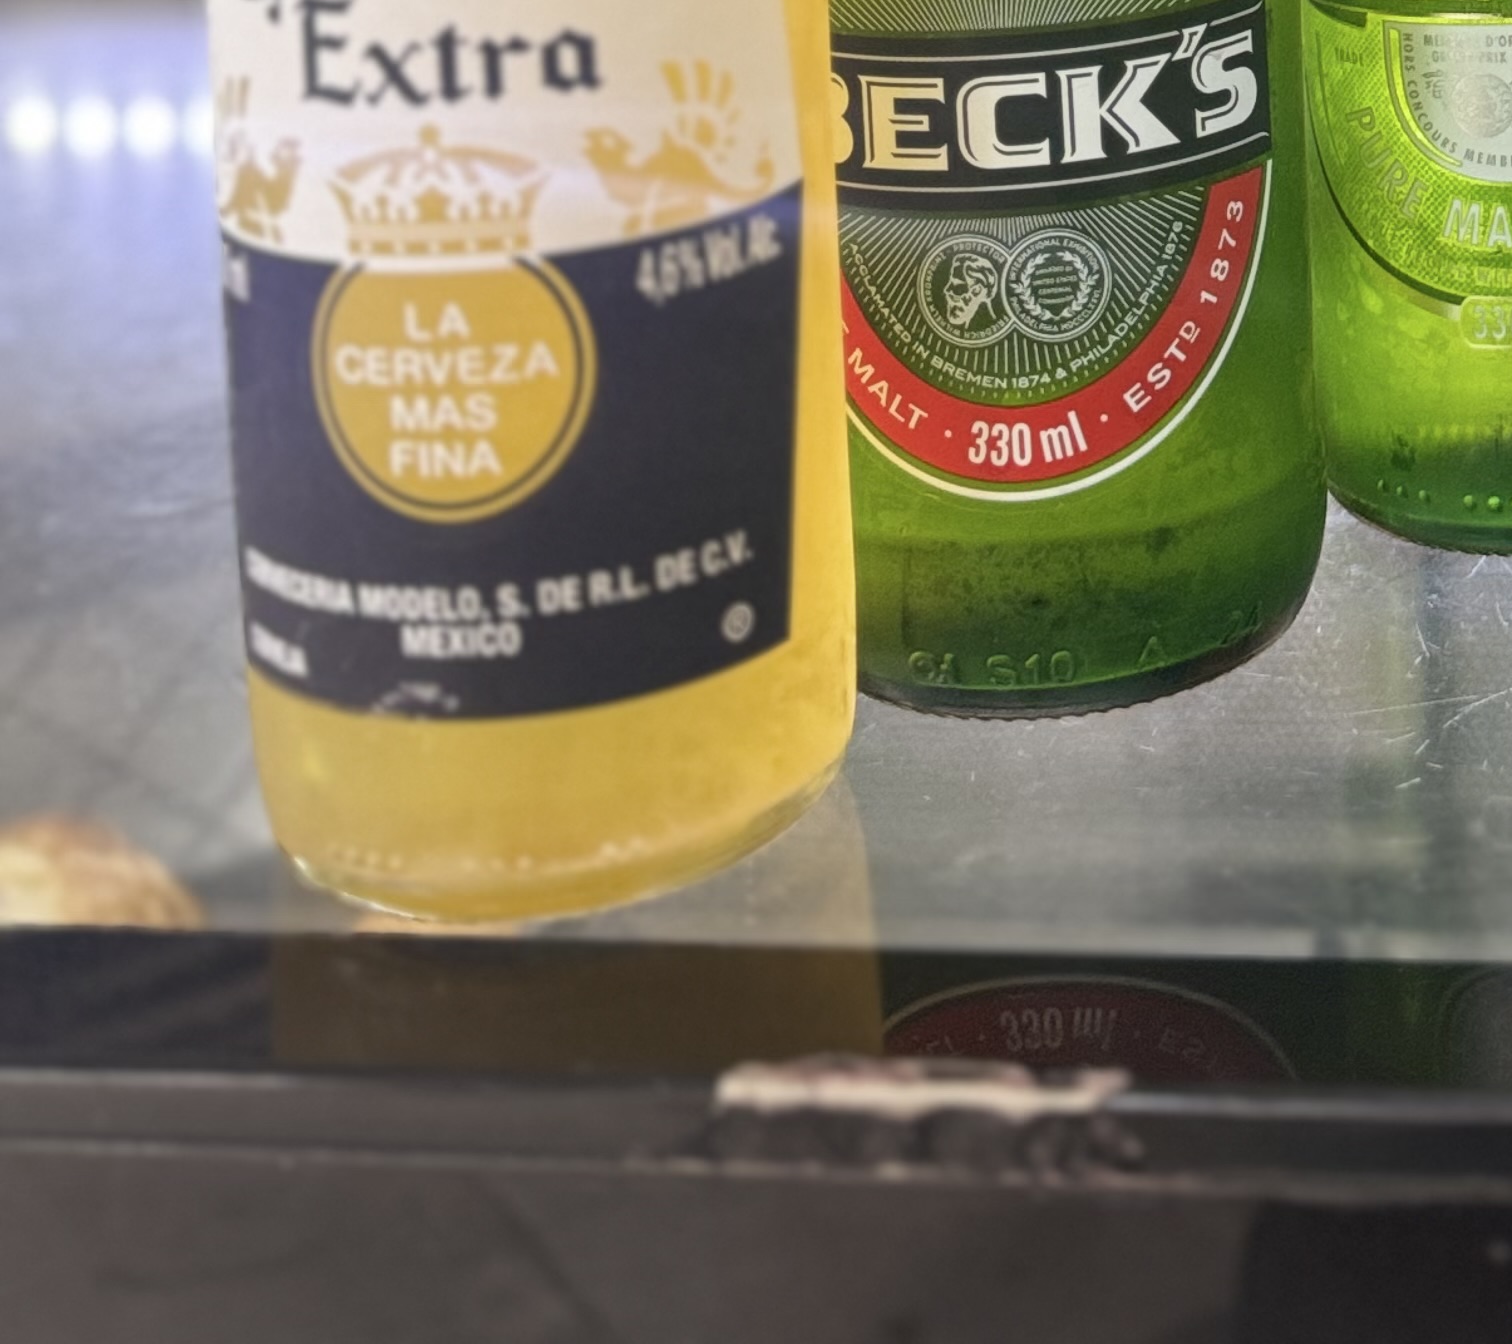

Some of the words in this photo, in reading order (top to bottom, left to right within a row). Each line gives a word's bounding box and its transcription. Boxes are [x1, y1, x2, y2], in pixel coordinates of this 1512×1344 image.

[1402, 32, 1416, 74] HORS
[831, 23, 1259, 172] ECK'S
[1406, 79, 1459, 154] CONCOURS
[1346, 105, 1429, 221] PURE
[403, 303, 471, 341] LA
[847, 348, 929, 432] MALT
[967, 419, 1033, 467] 330
[1039, 410, 1088, 464] ml
[1200, 198, 1244, 306] 1873
[850, 243, 912, 343] ACCLAMATED
[912, 341, 930, 360] IN
[930, 355, 1008, 390] BREMEN
[1011, 372, 1051, 389] 1874
[1055, 367, 1068, 380] &
[1070, 263, 1169, 373] PHILADELPHIA
[1161, 220, 1184, 260] 1876
[335, 342, 560, 386] CERVEZA
[389, 395, 498, 432] MAS
[389, 441, 503, 478] FINA
[496, 581, 531, 619] S.
[535, 574, 584, 617] DE
[654, 547, 698, 593] DE
[700, 527, 754, 577] C.V.
[400, 619, 524, 659] MEXICO
